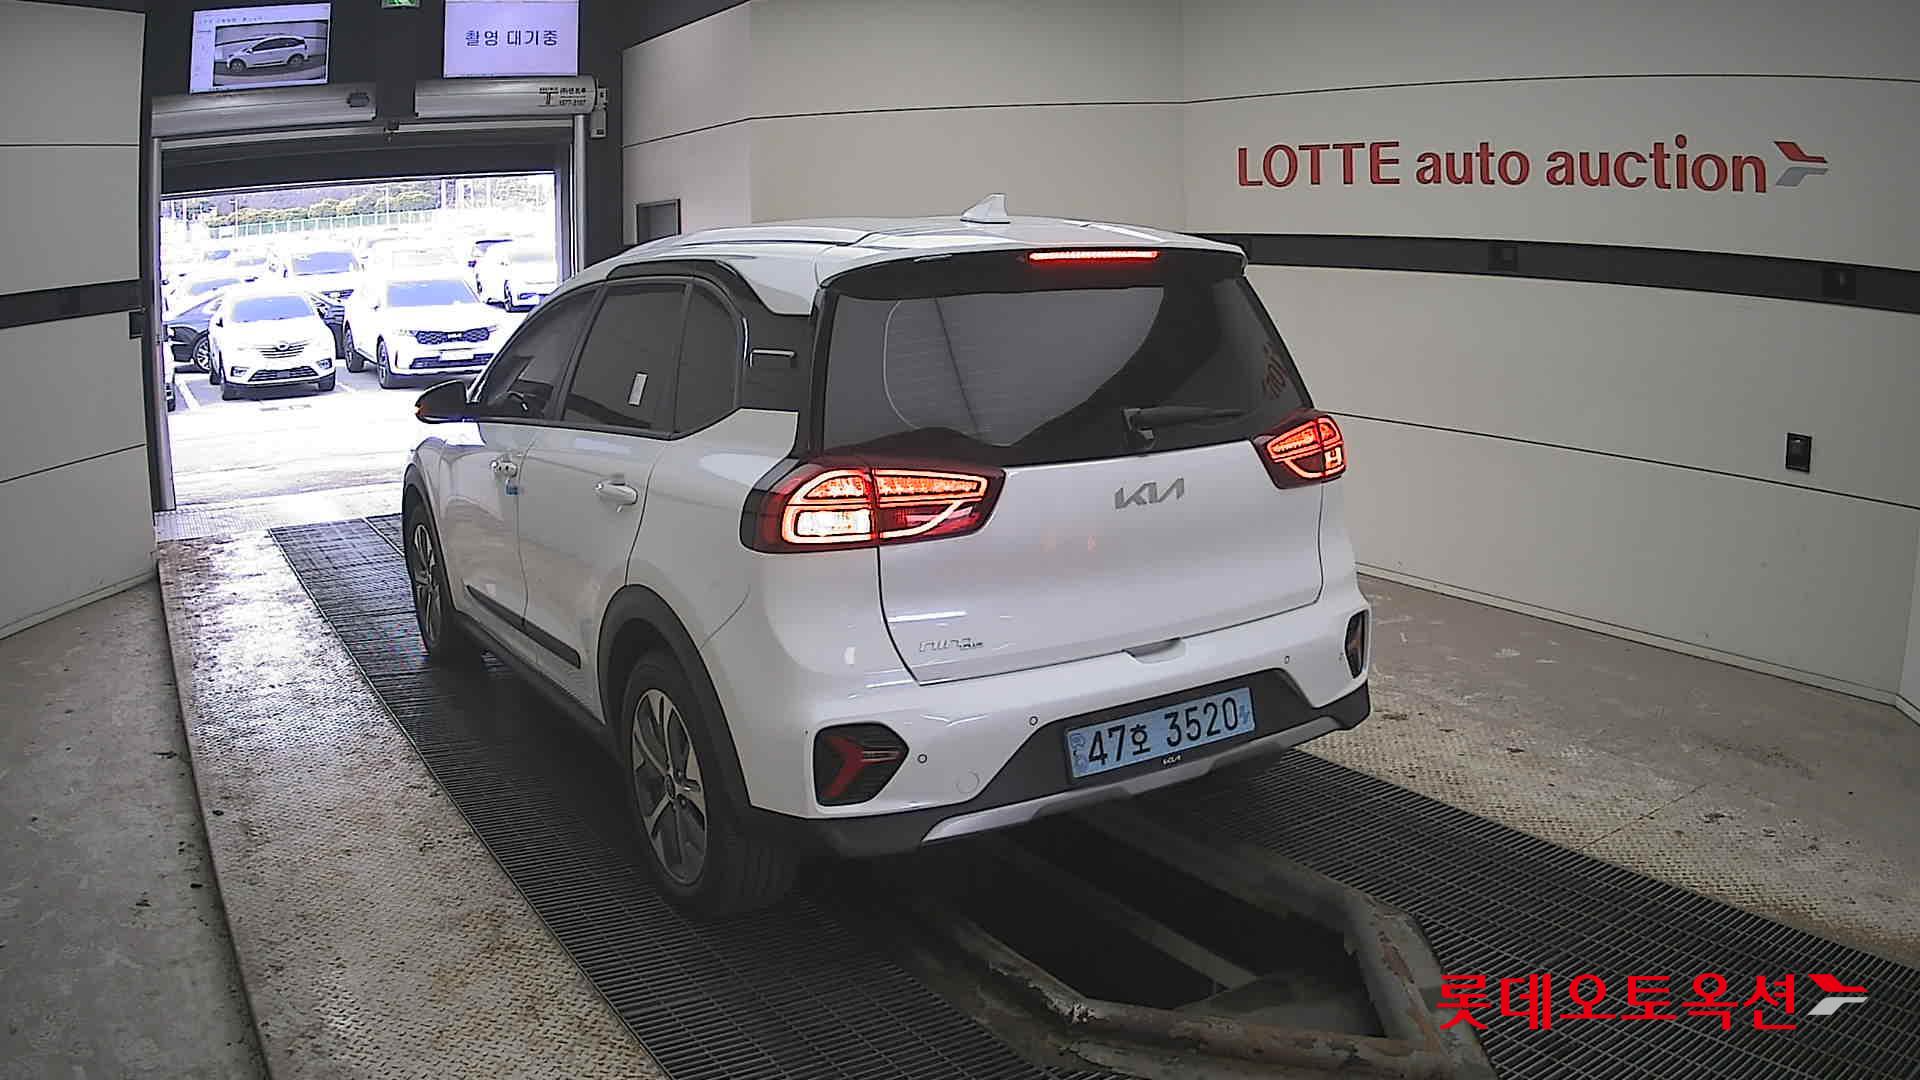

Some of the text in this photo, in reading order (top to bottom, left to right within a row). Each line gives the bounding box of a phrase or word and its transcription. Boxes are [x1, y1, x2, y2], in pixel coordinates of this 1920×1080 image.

[507, 30, 558, 46] 대기중
[1237, 134, 1767, 193] LOTTE auto auction
[1114, 477, 1185, 511] KIA
[1088, 723, 1152, 765] 47호
[1164, 697, 1239, 747] 3520
